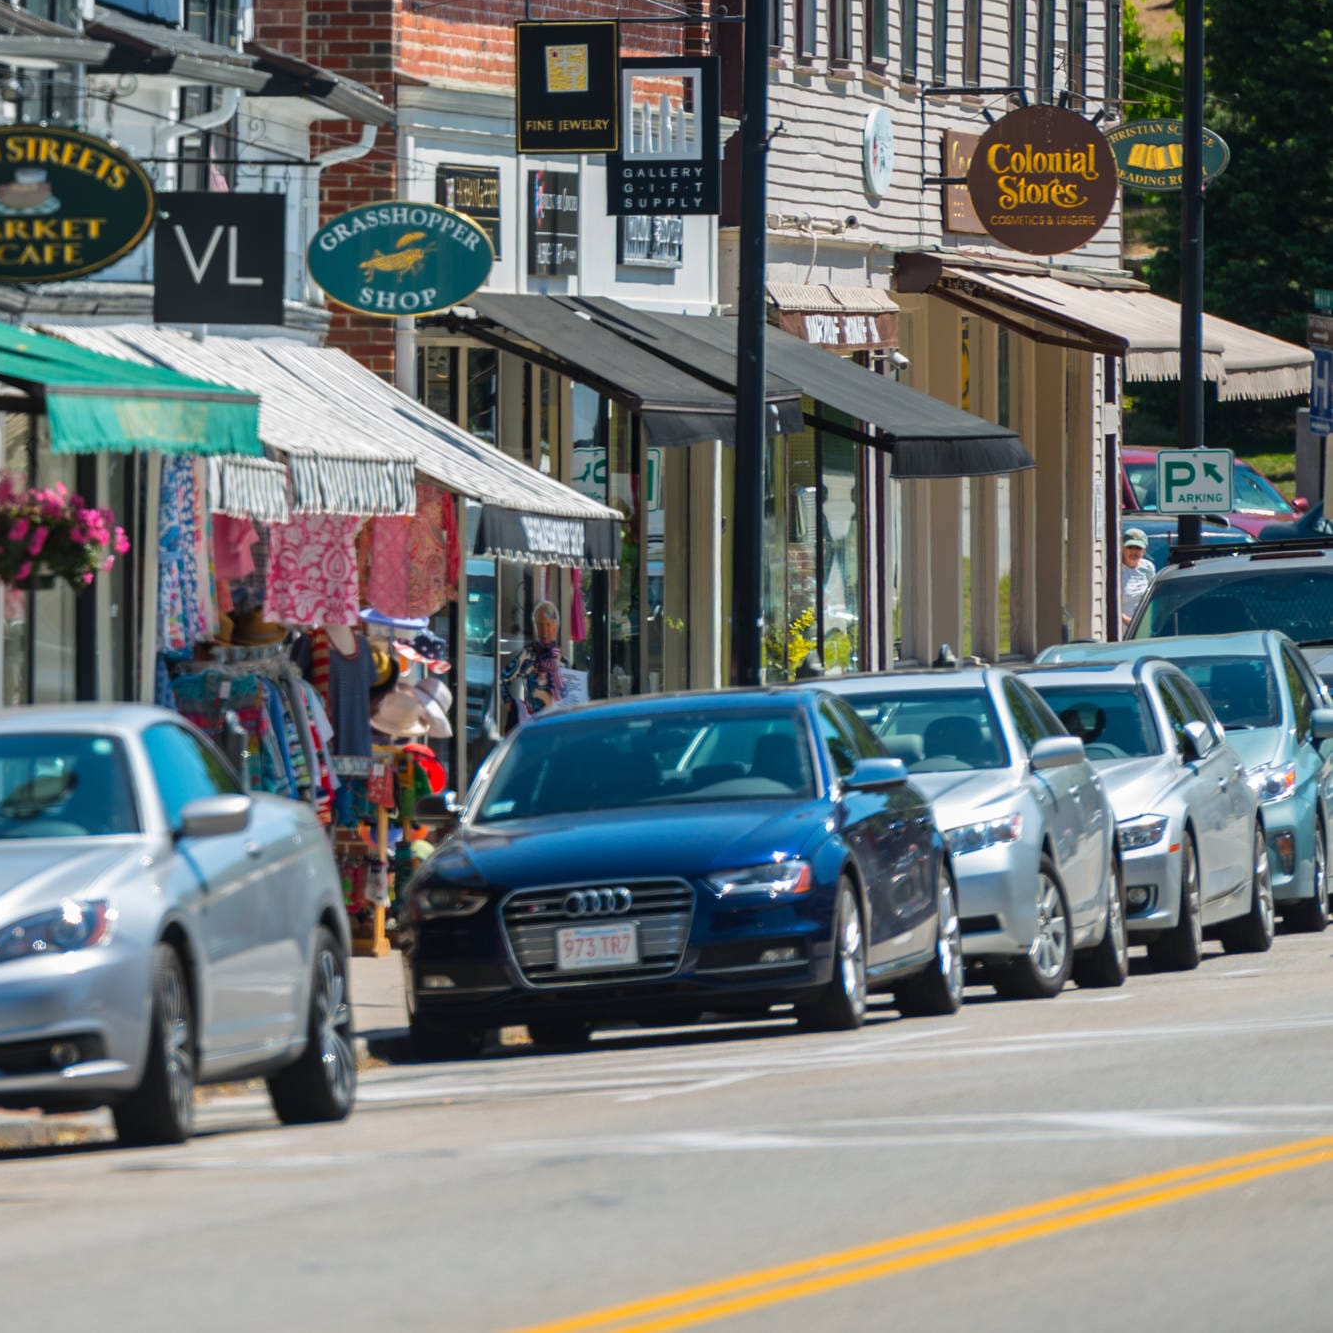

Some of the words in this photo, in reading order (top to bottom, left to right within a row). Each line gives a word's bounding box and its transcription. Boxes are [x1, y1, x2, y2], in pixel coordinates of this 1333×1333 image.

[525, 120, 554, 131] FINE
[557, 119, 609, 133] JEWELRY
[1109, 124, 1163, 143] HRISTIAN
[6, 135, 131, 189] STREETS
[623, 168, 703, 178] GALLERY
[987, 143, 1100, 181] Colonial
[1117, 169, 1166, 185] EADING
[624, 197, 703, 208] SUPPLY
[997, 175, 1089, 210] Stores
[319, 206, 481, 252] GRASSHOPPER
[174, 225, 264, 286] VL
[359, 286, 438, 311] SHOP
